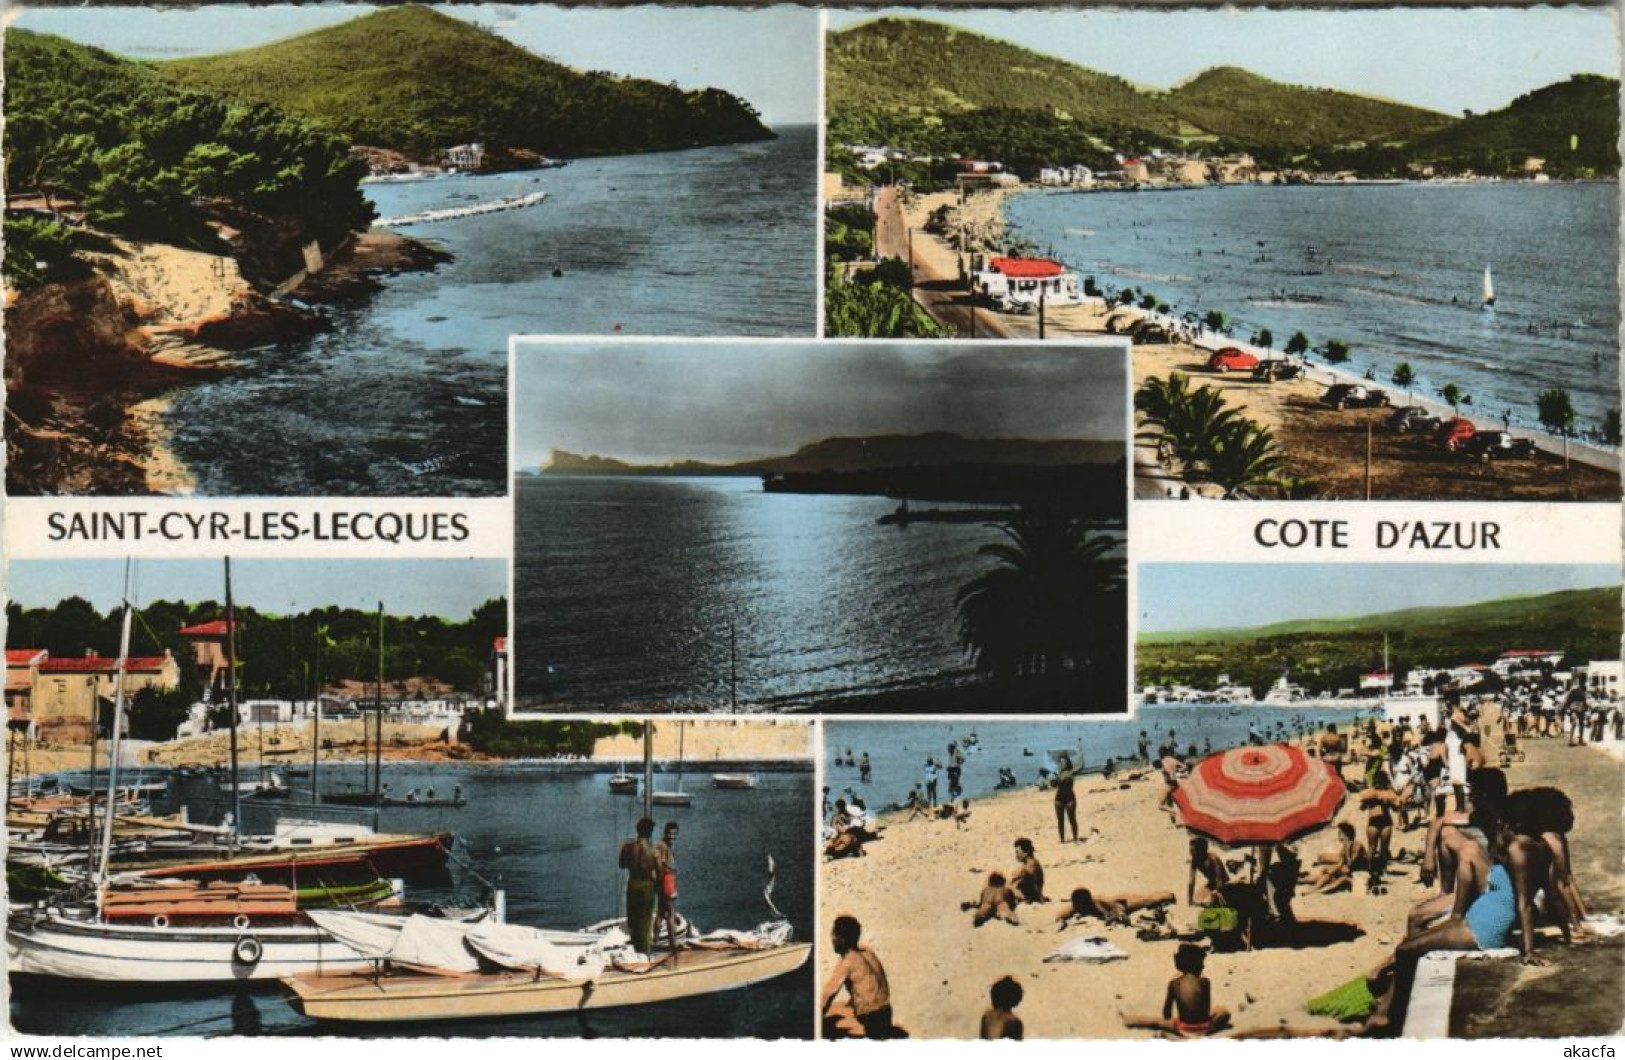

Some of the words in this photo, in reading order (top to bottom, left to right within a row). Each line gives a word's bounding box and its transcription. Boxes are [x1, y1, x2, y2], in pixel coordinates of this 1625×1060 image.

[48, 511, 470, 543] SAINT-CYR-LES-LECQUES
[1254, 518, 1348, 548] COTE
[1376, 521, 1501, 549] D'AZUR
